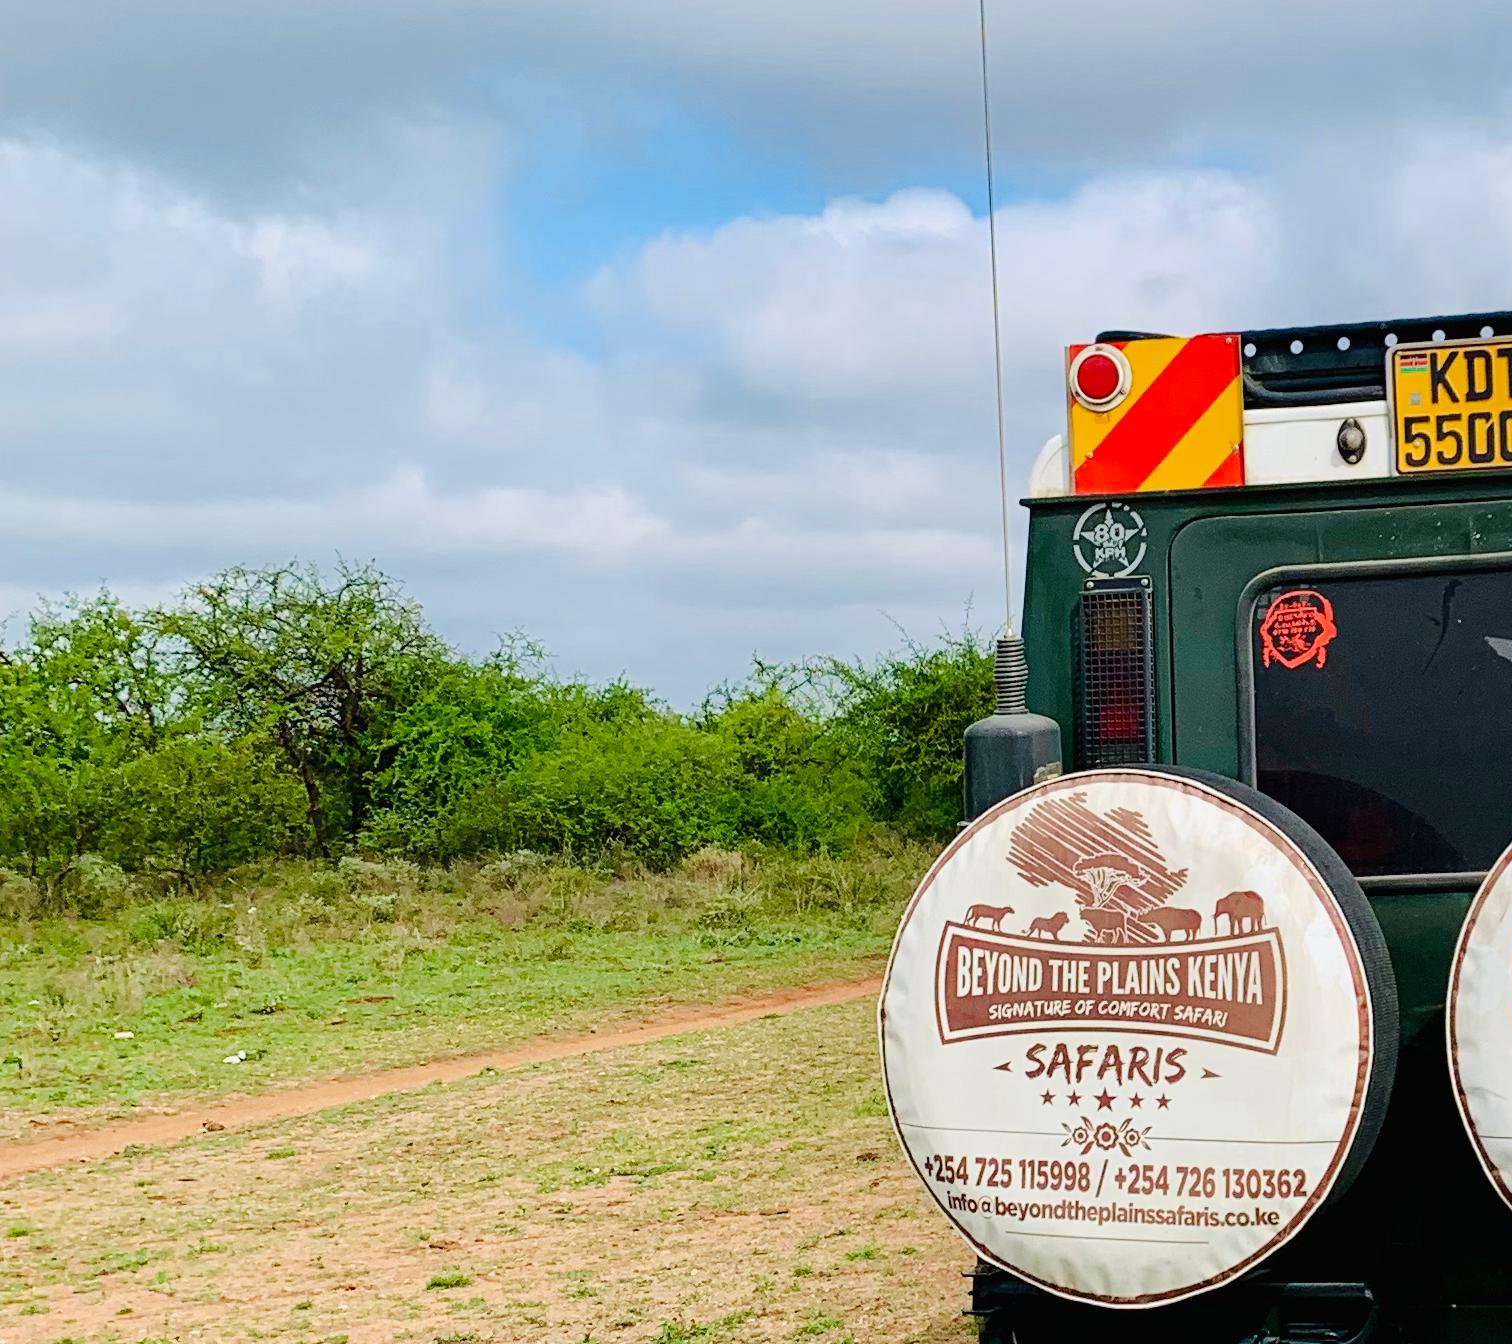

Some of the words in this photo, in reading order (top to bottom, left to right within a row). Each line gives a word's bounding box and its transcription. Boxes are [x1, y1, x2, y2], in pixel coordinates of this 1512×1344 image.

[1094, 523, 1125, 544] 80
[956, 945, 1043, 998] BEYOND
[1049, 959, 1090, 994] THE
[1097, 957, 1181, 996] PLAINS
[1187, 951, 1264, 1006] KENYA
[988, 999, 1072, 1020] SIGNATURE
[1074, 999, 1096, 1016] OF
[1097, 1001, 1171, 1020] COMFORT
[1173, 1006, 1228, 1028] SAFARI
[1025, 1043, 1188, 1087] SAFARIS
[924, 1154, 969, 1186] +254
[975, 1157, 1012, 1188] 725
[1019, 1159, 1091, 1193] 115998
[1095, 1159, 1109, 1198] /
[1114, 1164, 1169, 1196] +254
[1176, 1167, 1216, 1199] 726
[1222, 1168, 1307, 1199] 130362
[947, 1191, 1280, 1227] info@beyondtheplainssafaris.co.ke
